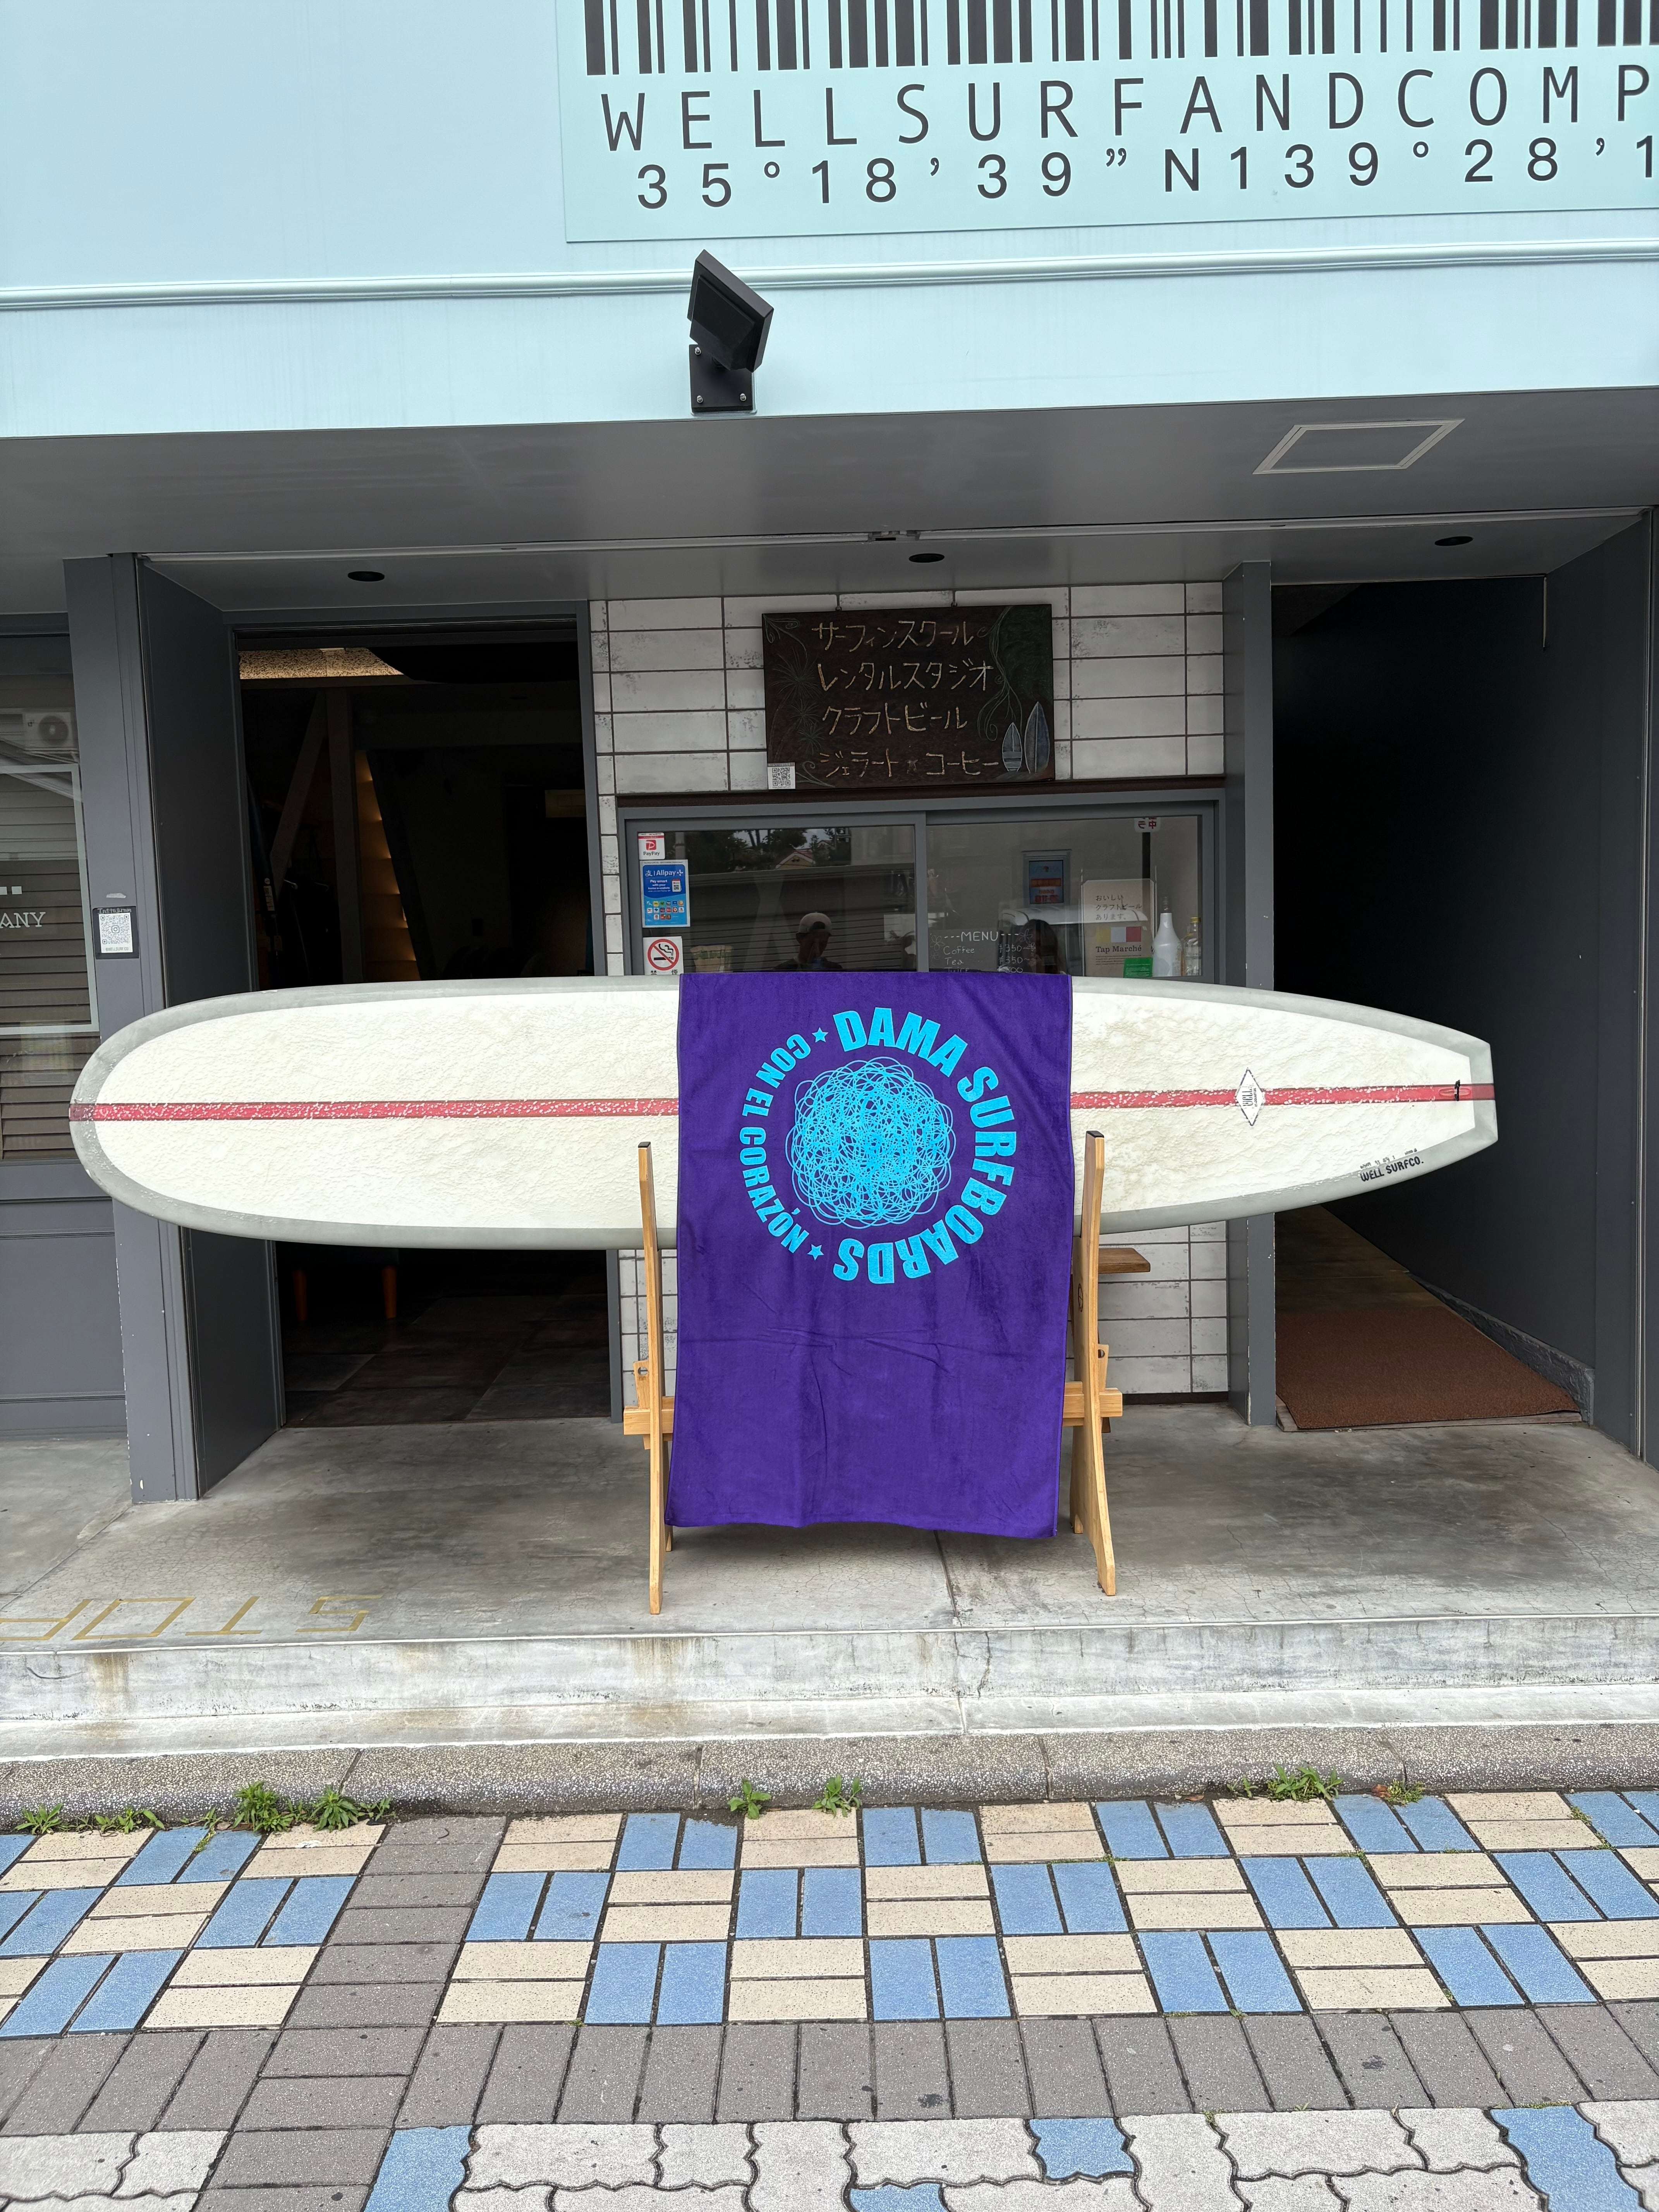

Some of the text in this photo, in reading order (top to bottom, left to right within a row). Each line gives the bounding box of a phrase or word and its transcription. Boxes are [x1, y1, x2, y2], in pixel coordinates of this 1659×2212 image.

[812, 620, 974, 652] サーフィンスクール
[818, 658, 994, 691] レンタルスタジオ
[822, 702, 968, 735] クラフトビール
[819, 748, 999, 777] ジェラート コーヒー
[943, 946, 975, 955] Coffee
[945, 957, 964, 965] Tea
[1096, 946, 1110, 954] Tap
[756, 1034, 811, 1089] CON
[742, 1087, 774, 1116] EL
[833, 1007, 1017, 1284] DAMA SURFBOARDS
[1360, 1168, 1384, 1182] WELL
